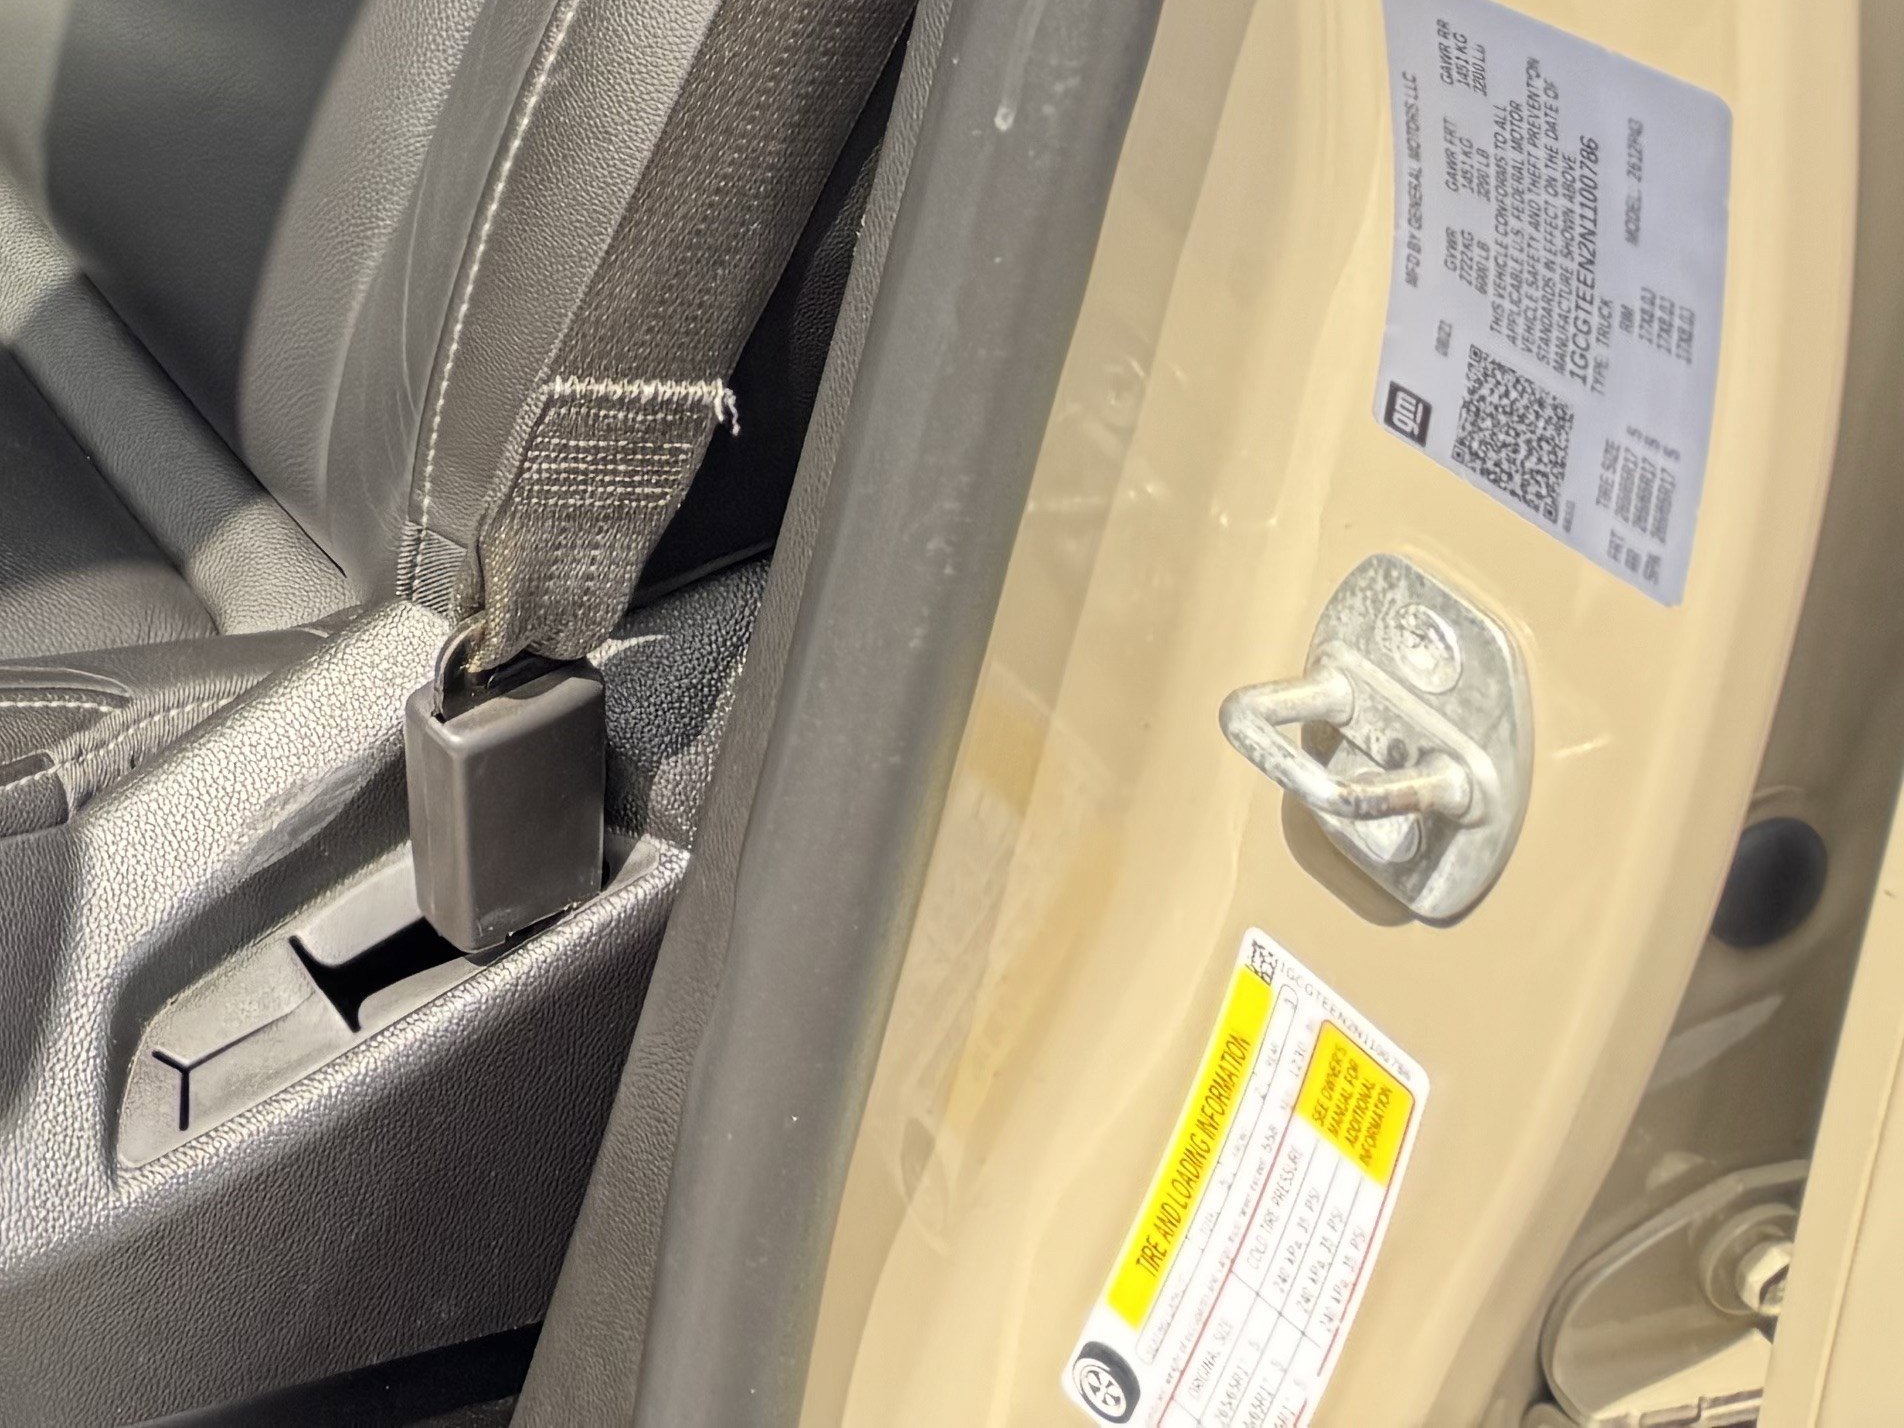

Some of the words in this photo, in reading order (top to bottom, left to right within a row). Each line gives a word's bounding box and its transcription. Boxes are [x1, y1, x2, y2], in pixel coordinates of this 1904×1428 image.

[1437, 16, 1450, 40] RR
[1454, 30, 1467, 55] KG
[1402, 69, 1417, 101] LLC
[1439, 41, 1453, 86] GAWR
[1456, 54, 1470, 88] 1451
[1526, 55, 1539, 149] PREVENTION
[1543, 76, 1557, 101] OF
[1404, 99, 1420, 162] MOTORS
[1443, 115, 1456, 147] FRT
[1492, 100, 1506, 130] ALL
[1509, 98, 1523, 154] MOTOR
[1544, 100, 1558, 141] DATE
[1459, 134, 1473, 159] KG
[1476, 146, 1490, 168] LB
[1494, 130, 1506, 153] TO
[1544, 141, 1558, 173] THE
[1444, 146, 1458, 193] GAWR
[1461, 158, 1474, 194] 1451
[1511, 155, 1524, 222] FEDERAL
[1527, 150, 1540, 197] THEFT
[1544, 173, 1558, 198] ON
[1407, 161, 1421, 232] GENERAL
[1494, 152, 1507, 238] CONFORMS
[1527, 198, 1540, 232] AND
[1406, 230, 1421, 255] BY
[1444, 225, 1457, 273] GVWR
[1460, 227, 1473, 252] KG
[1477, 239, 1489, 261] LB
[1543, 199, 1558, 256] EFFECT
[1560, 204, 1574, 262] SHOWN
[1459, 249, 1472, 286] 2722
[1493, 236, 1508, 301] VEHICLE
[1525, 233, 1539, 291] SAFETY
[1543, 256, 1555, 274] IN
[1568, 132, 1599, 386] 1GCGTEEN2N1100786
[1489, 299, 1504, 336] THIS
[1505, 253, 1523, 346] APPLICABLE
[1535, 273, 1555, 366] STANDARDS
[1552, 262, 1573, 376] MANUFACTURE
[1595, 294, 1613, 348] TRUCK
[1618, 302, 1634, 335] RIM
[1520, 290, 1538, 355] VEHICLE
[1393, 390, 1421, 436] gm
[1194, 1027, 1251, 1142] INFORMATION
[1326, 1086, 1352, 1138] MANUAL
[1343, 1057, 1362, 1088] FOR
[1311, 1098, 1329, 1127] SEE
[1343, 1075, 1375, 1148] ADDITIONAL
[1358, 1083, 1393, 1167] INFORMATION
[1165, 1127, 1210, 1214] LOADING
[1152, 1201, 1182, 1245] AND
[1246, 1231, 1268, 1273] COLD
[1270, 1143, 1303, 1211] PRESSURE
[1135, 1235, 1167, 1278] TIRE
